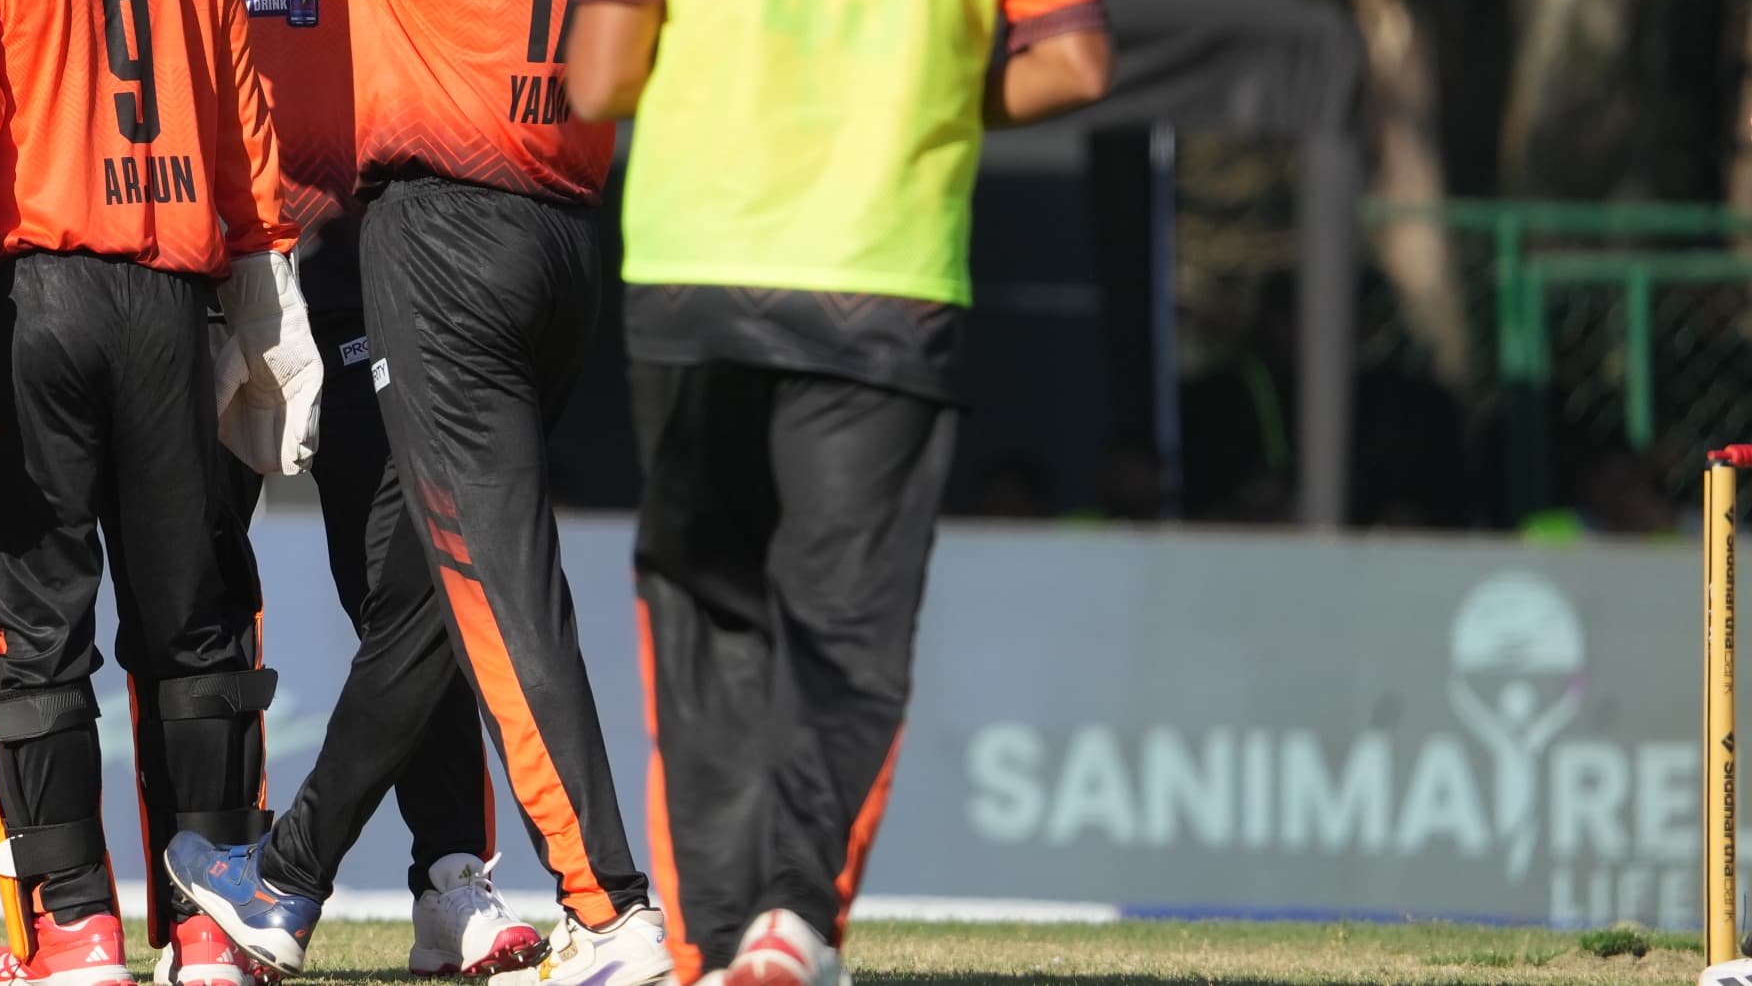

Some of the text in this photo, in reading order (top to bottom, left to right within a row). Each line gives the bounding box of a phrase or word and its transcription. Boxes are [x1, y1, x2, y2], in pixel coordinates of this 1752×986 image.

[104, 156, 196, 205] ARJUN
[965, 720, 1486, 860] SANIMA
[1548, 865, 1696, 931] LIFE
